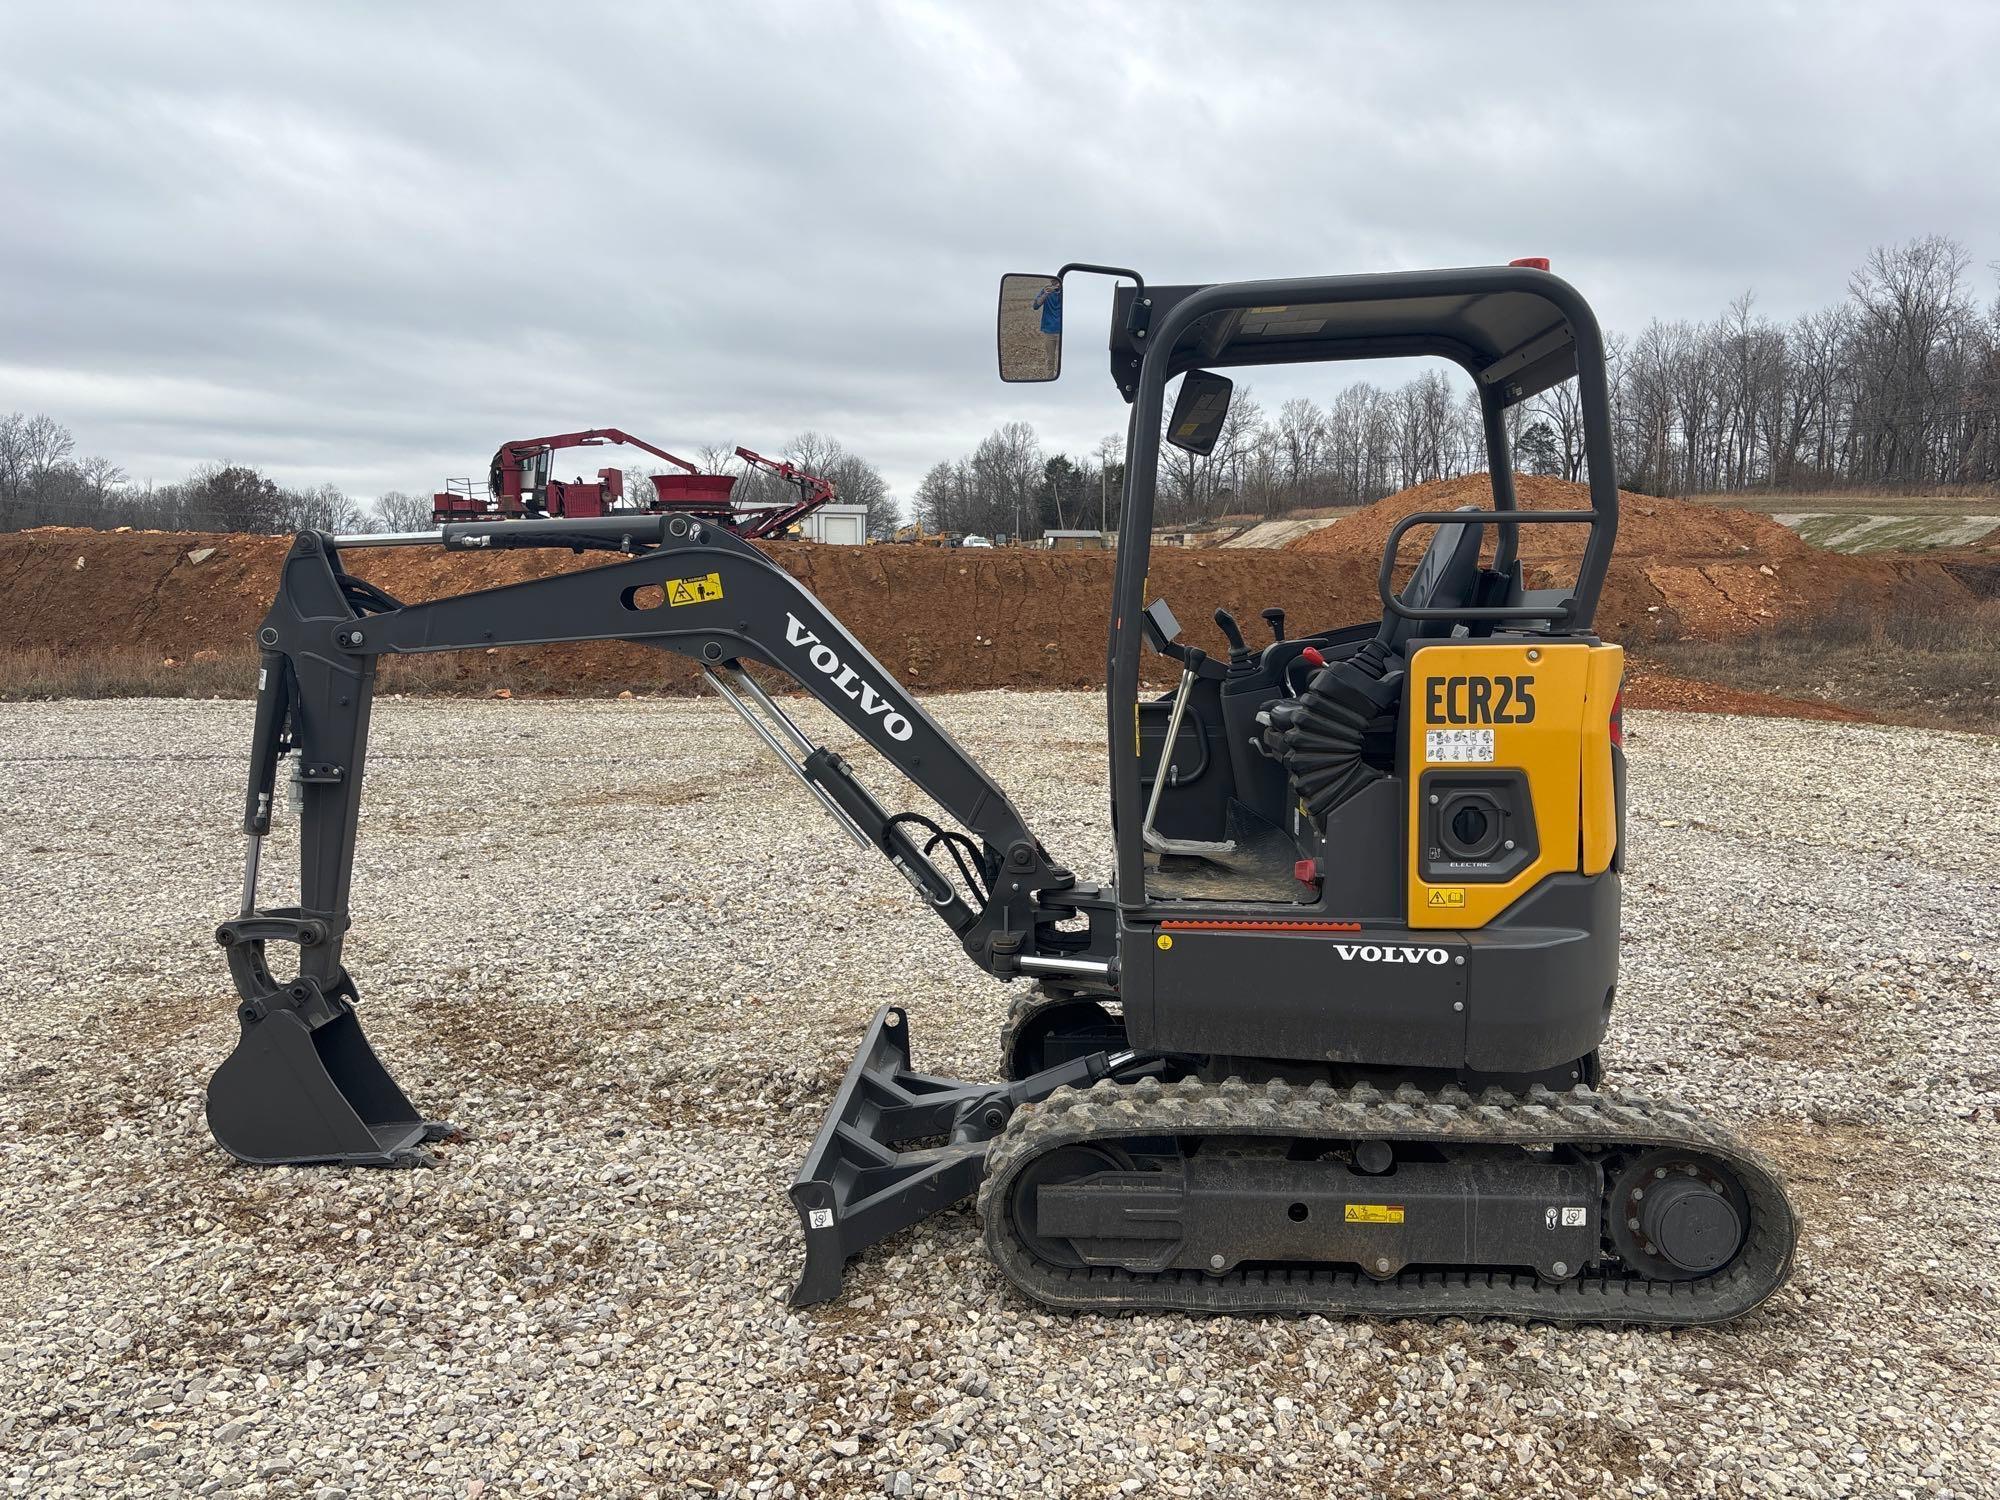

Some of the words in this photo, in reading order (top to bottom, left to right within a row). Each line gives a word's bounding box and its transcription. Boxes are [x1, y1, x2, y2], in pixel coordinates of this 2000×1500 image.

[786, 612, 913, 741] VOLVO
[1426, 676, 1536, 724] ECR25
[1333, 945, 1449, 965] VOLVO
